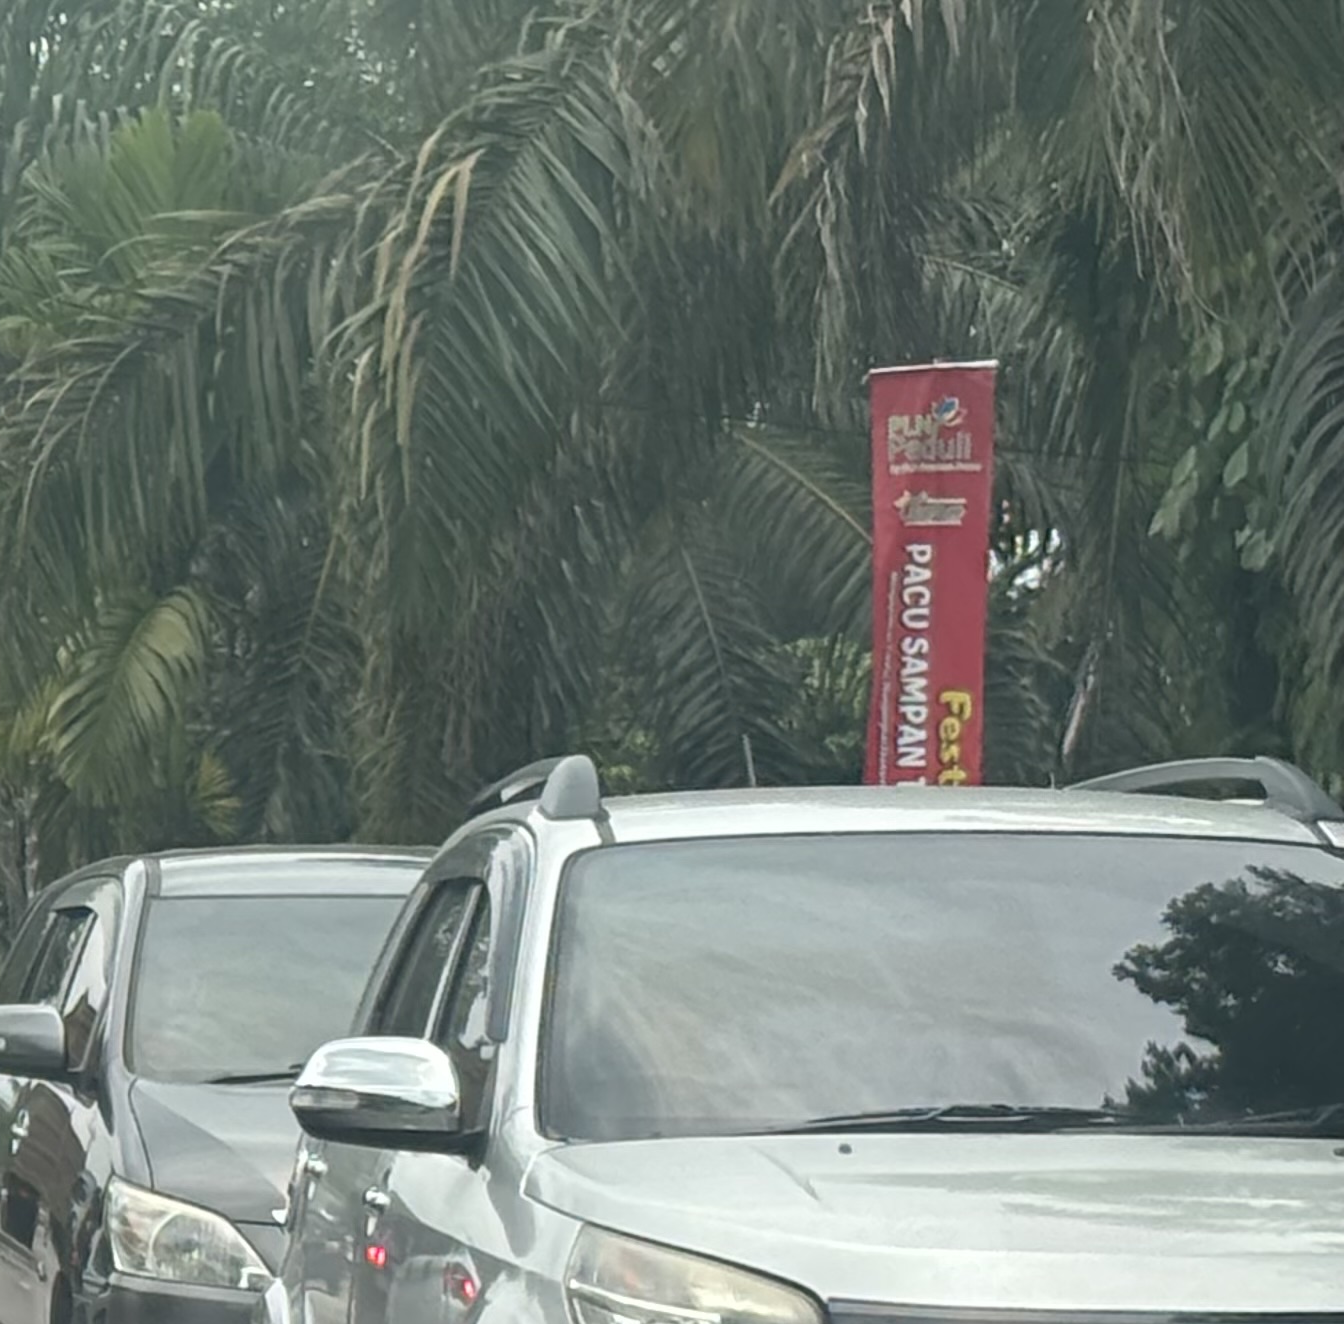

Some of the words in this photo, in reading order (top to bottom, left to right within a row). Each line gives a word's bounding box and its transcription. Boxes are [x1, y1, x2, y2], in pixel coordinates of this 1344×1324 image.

[888, 414, 932, 436] PLN
[889, 430, 972, 462] Peduli
[901, 543, 932, 629] PACU
[896, 636, 930, 767] SAMPAN
